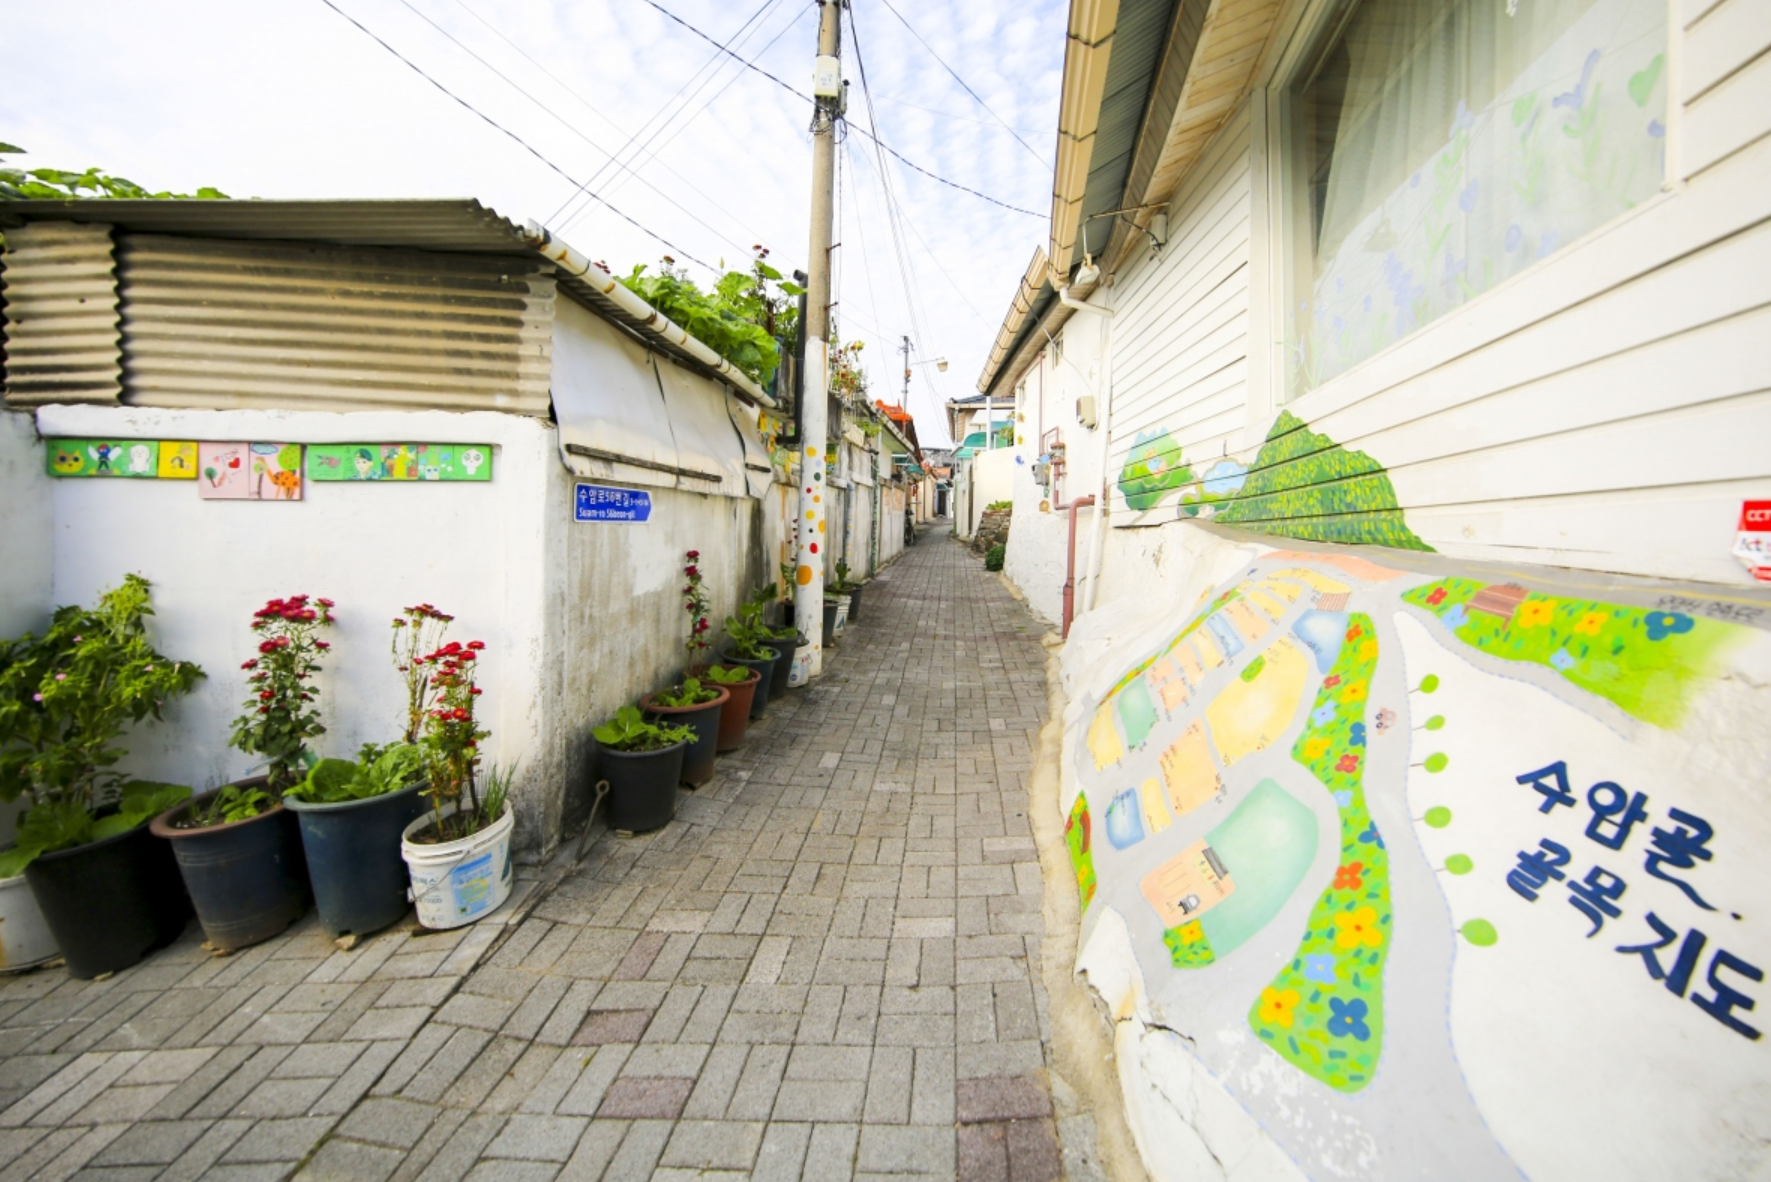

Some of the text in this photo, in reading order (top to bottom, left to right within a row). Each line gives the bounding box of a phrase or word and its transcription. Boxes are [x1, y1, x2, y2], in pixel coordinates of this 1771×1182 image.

[579, 488, 630, 507] 수암로56번길
[579, 507, 605, 517] Suam-ro
[1506, 838, 1764, 1041] 골목 지도
